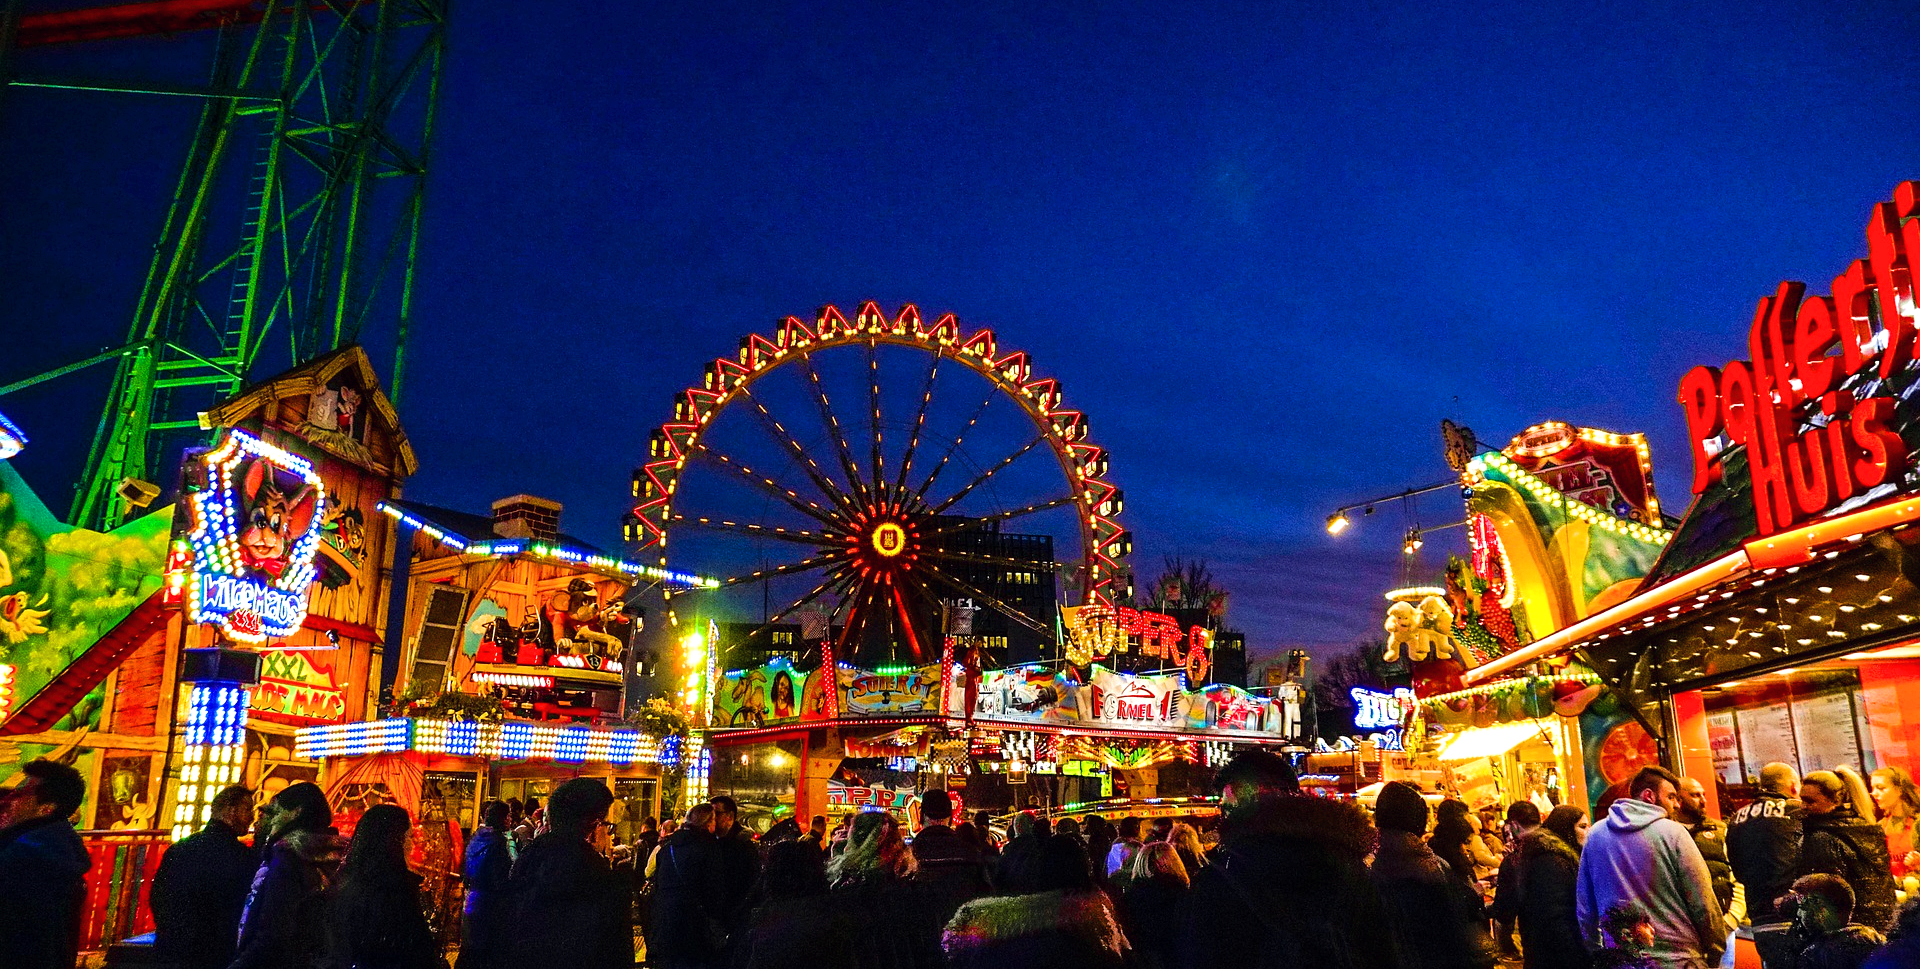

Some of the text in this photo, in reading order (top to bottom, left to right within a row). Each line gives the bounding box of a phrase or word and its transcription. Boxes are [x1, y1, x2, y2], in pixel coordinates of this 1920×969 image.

[1746, 391, 1890, 536] Huis
[1065, 604, 1208, 682] SUPER 8
[265, 651, 308, 682] XXL
[910, 676, 923, 695] 8
[1091, 684, 1173, 721] FORMEL 1
[291, 688, 341, 720] MAUS
